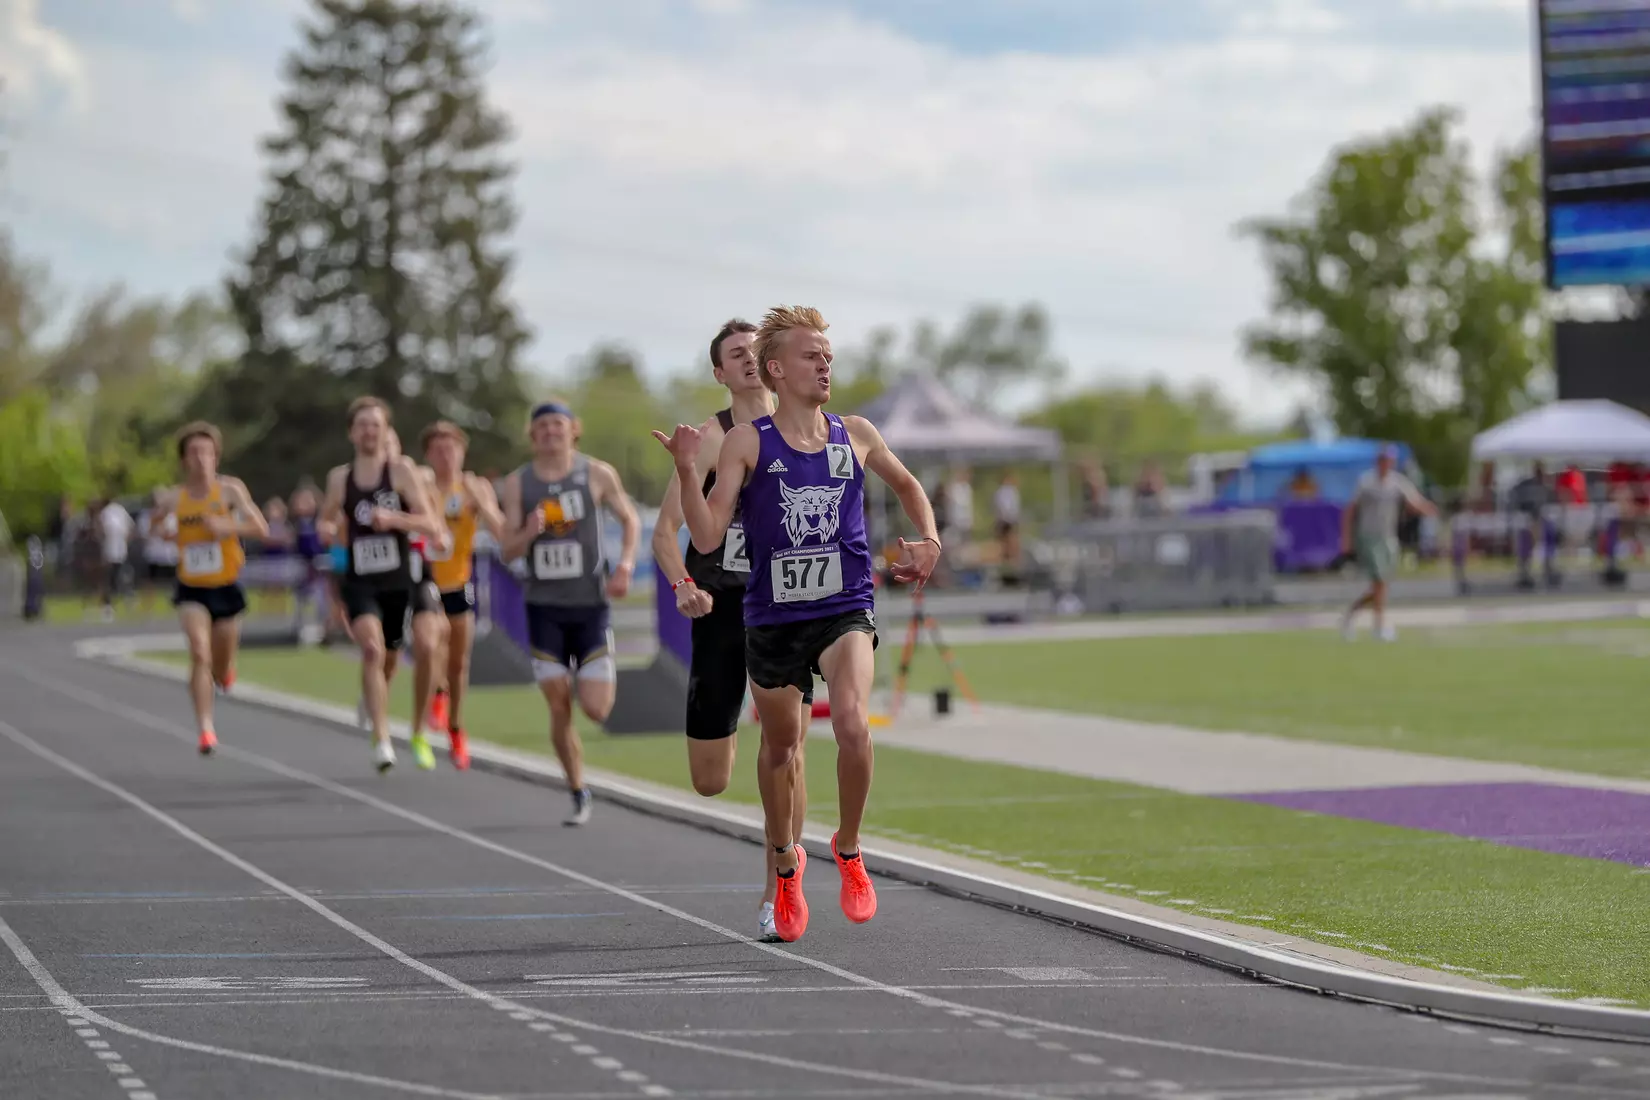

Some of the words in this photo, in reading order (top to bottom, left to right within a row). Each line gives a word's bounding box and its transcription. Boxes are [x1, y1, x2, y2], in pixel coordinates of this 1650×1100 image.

[832, 445, 850, 477] 2
[791, 547, 824, 555] CHAMPIONSHIPS
[781, 556, 830, 590] 577
